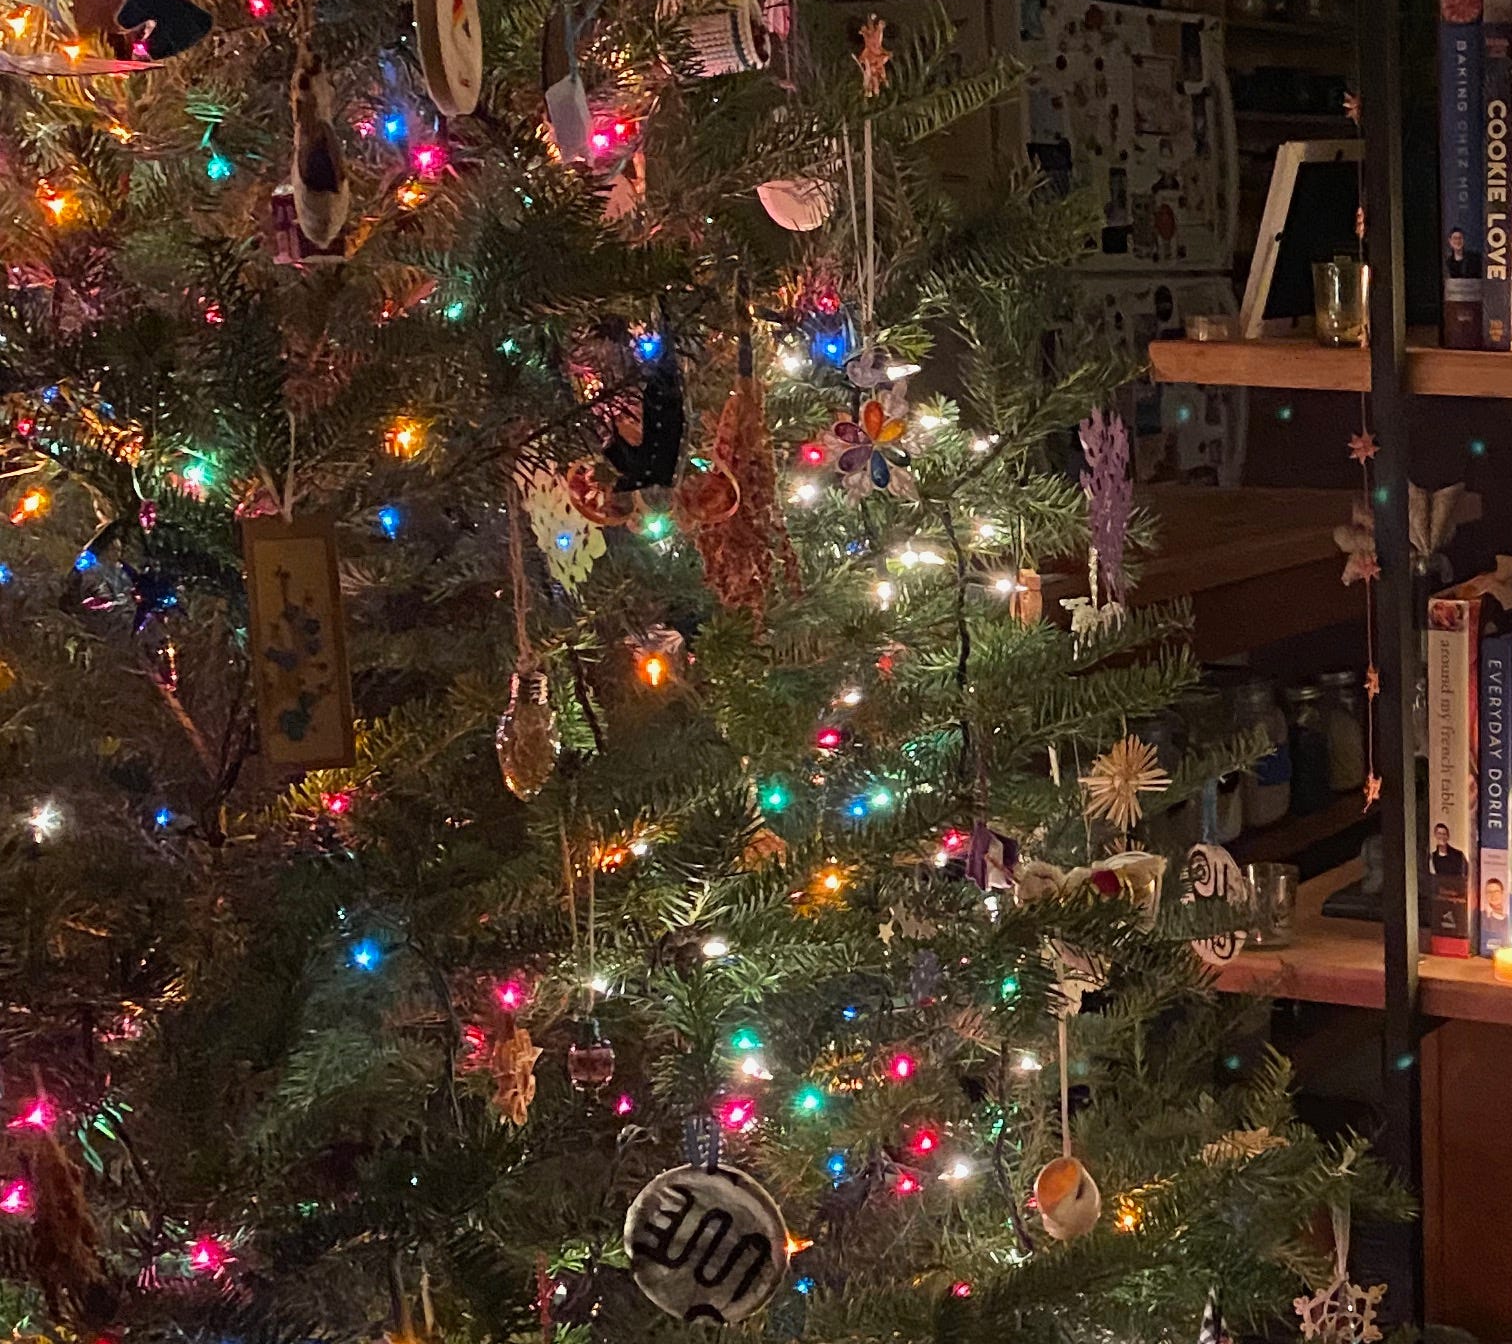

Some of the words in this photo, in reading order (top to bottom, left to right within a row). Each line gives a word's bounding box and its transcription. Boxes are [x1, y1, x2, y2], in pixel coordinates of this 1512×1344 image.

[1456, 40, 1469, 111] BAKING
[1486, 100, 1507, 202] COOKIE
[1486, 213, 1507, 280] LOVE
[1440, 639, 1453, 693] around
[1438, 699, 1452, 721] my
[1488, 659, 1504, 761] EVERYDAY
[1440, 726, 1455, 773] french
[1440, 778, 1456, 814] table
[1488, 768, 1502, 830] DORIE
